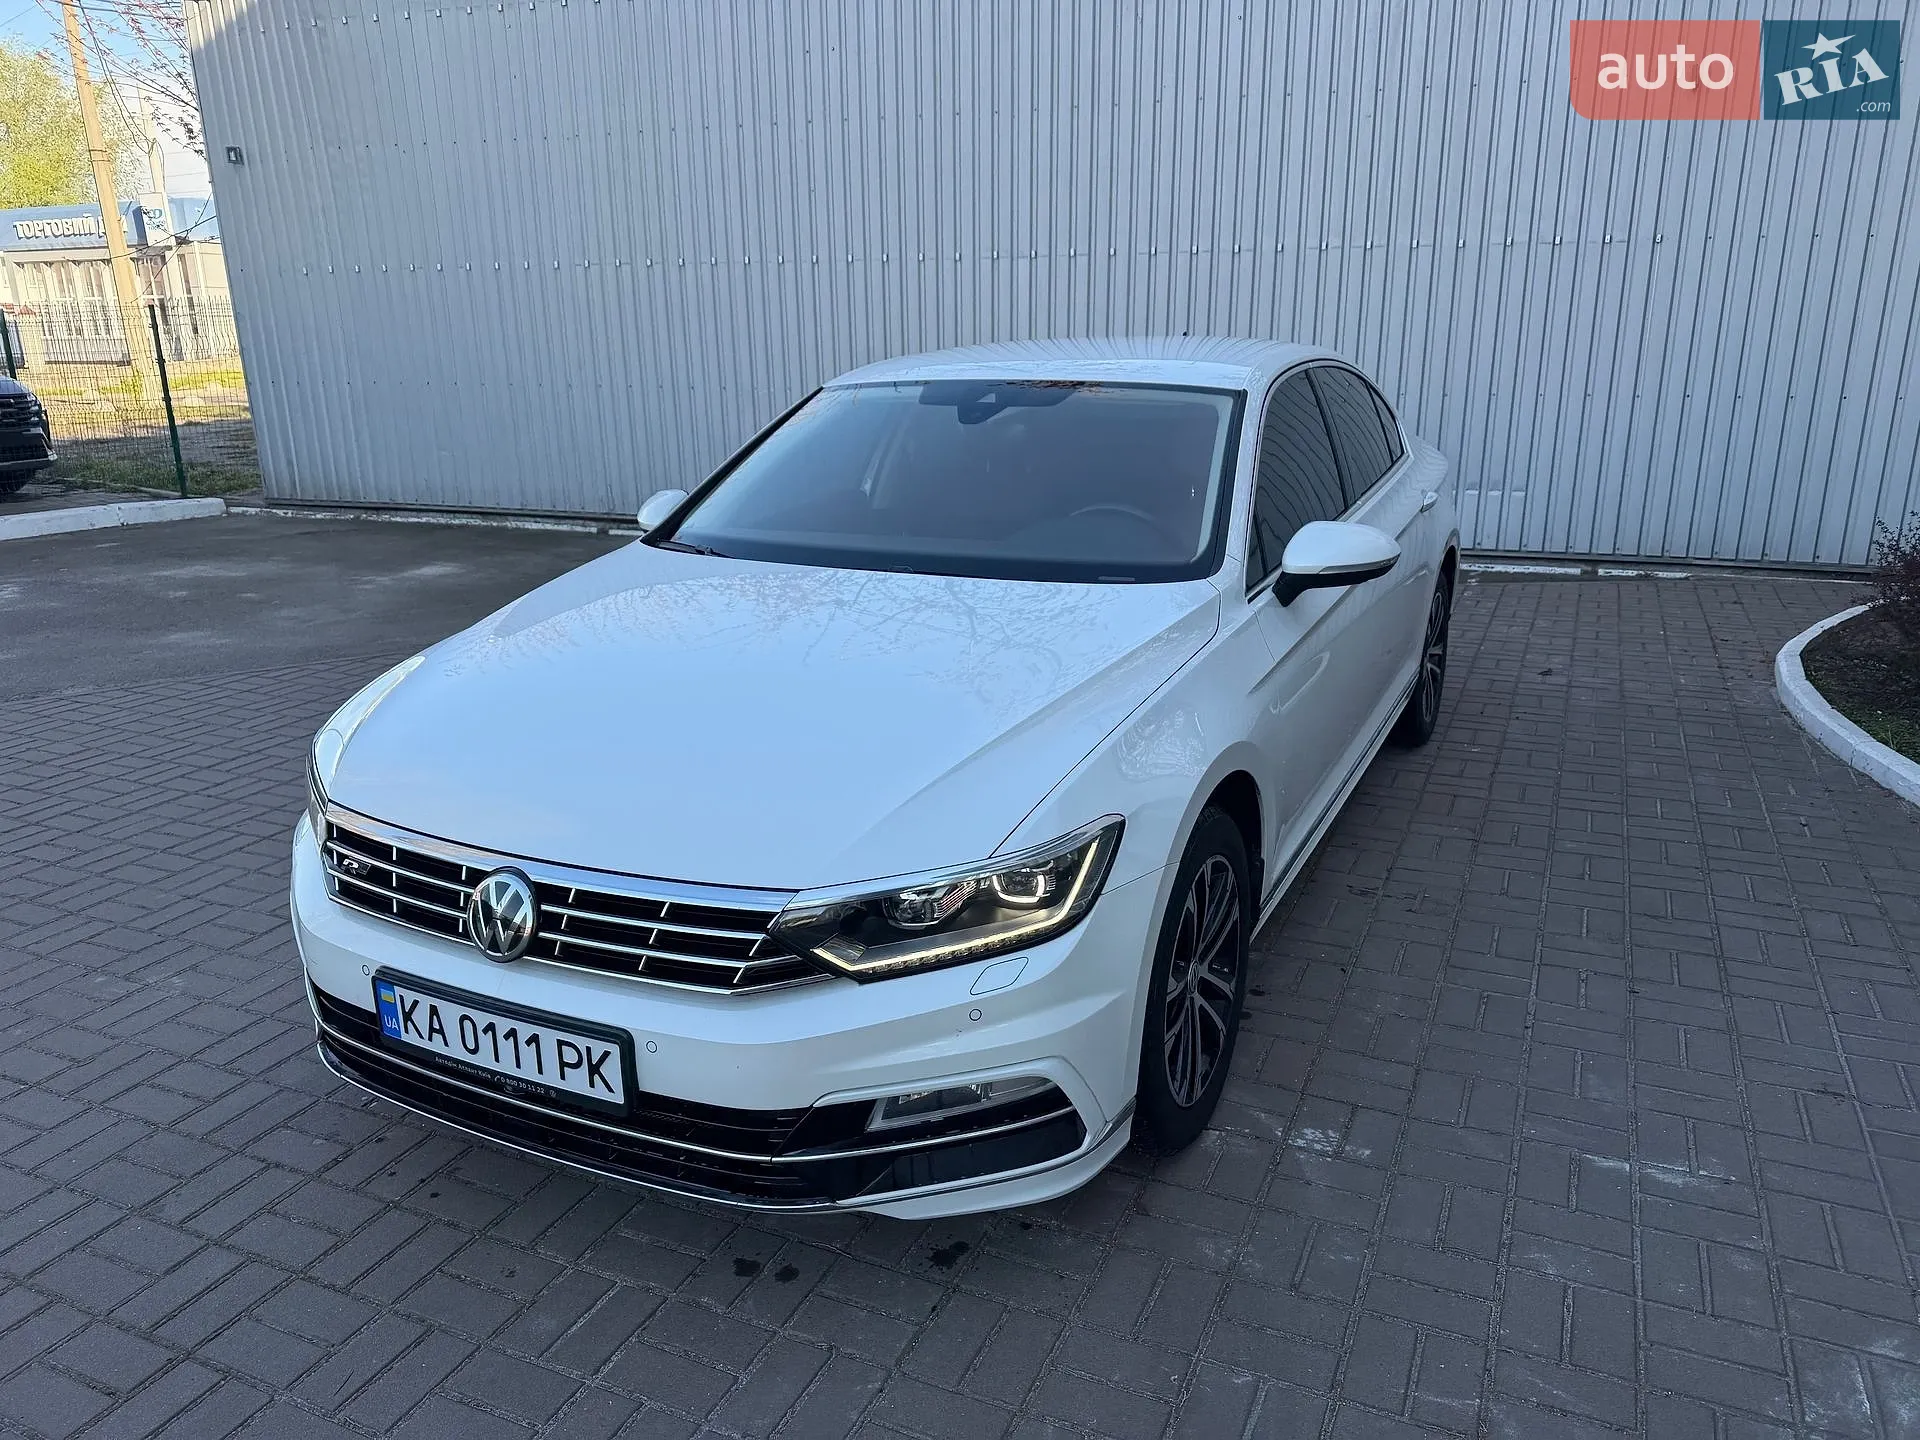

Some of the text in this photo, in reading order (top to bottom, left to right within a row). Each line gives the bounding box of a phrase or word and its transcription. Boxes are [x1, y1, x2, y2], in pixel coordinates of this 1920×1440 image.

[13, 213, 96, 238] ТОРГОВИЙ
[383, 1015, 400, 1032] UA
[399, 993, 616, 1094] KA 0111 PK
